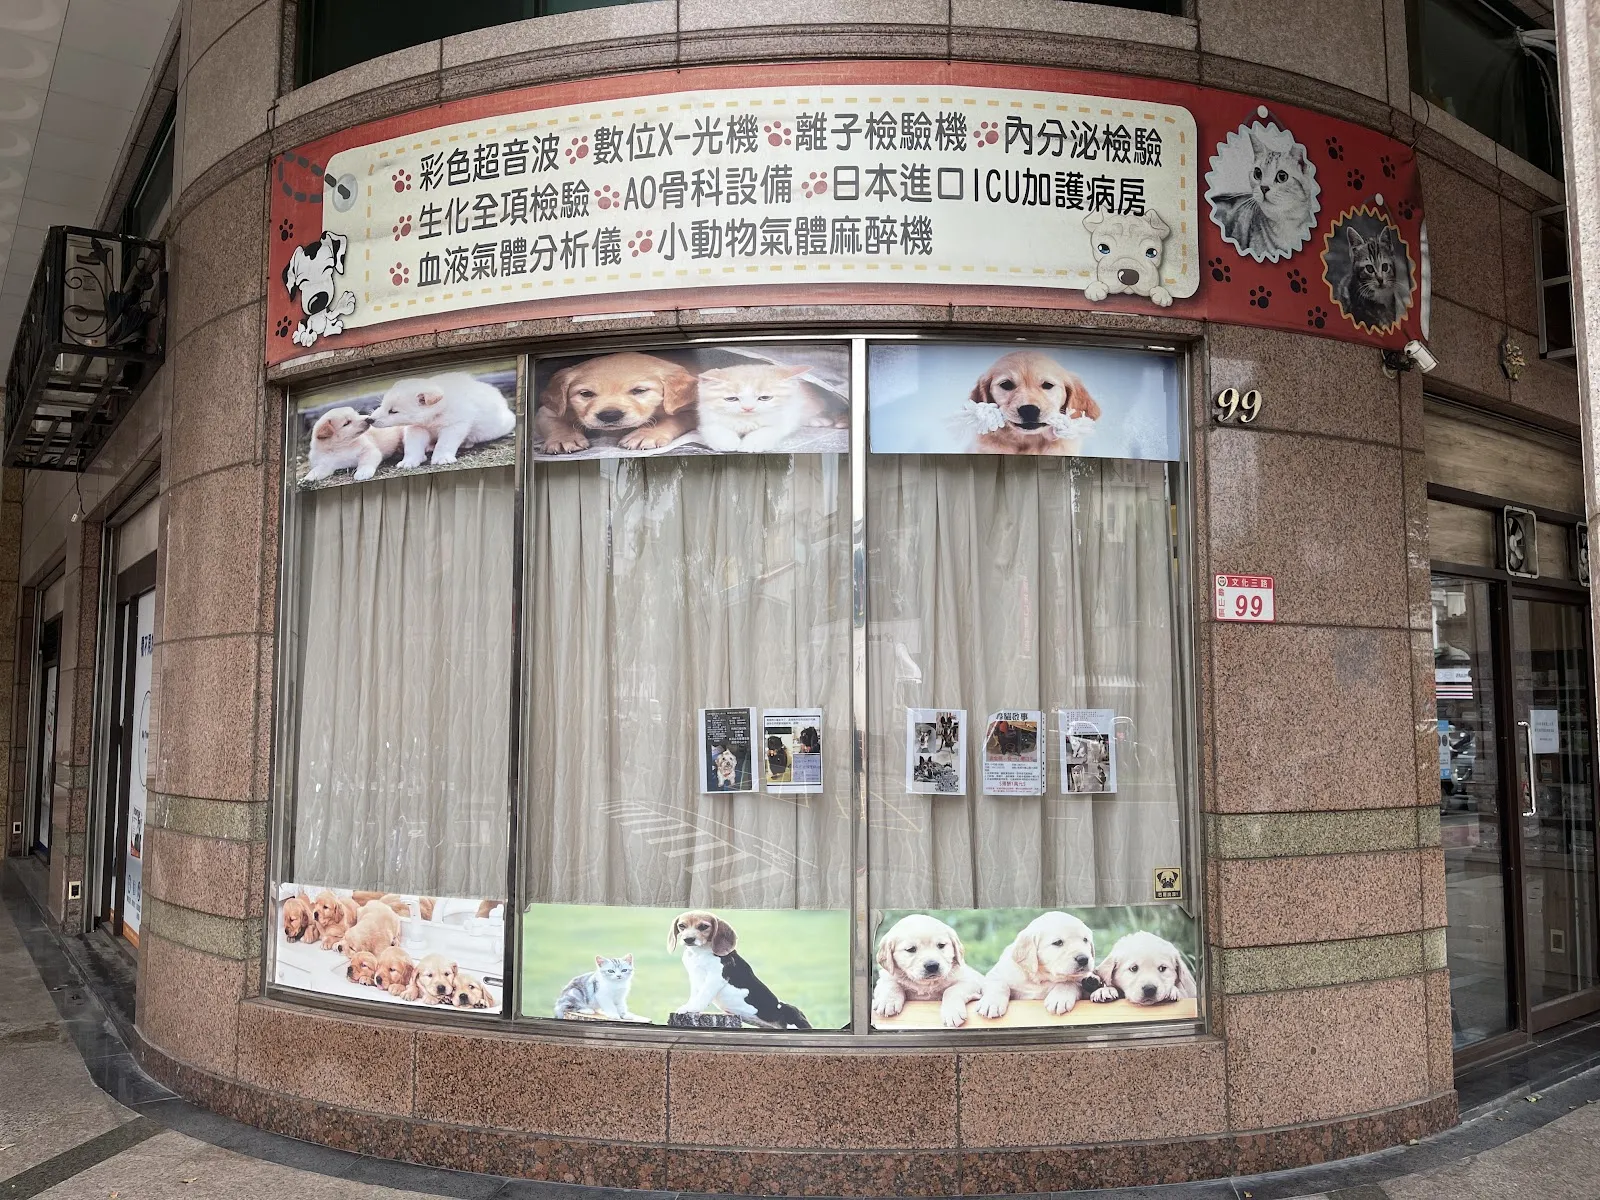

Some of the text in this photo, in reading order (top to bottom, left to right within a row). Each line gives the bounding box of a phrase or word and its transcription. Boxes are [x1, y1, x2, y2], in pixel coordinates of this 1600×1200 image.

[418, 132, 560, 192] 彩色超音波
[795, 111, 968, 151] 離子檢驗機
[1005, 115, 1163, 167] 內分泌檢驗
[418, 178, 591, 240] 生化全項檢驗
[833, 162, 1146, 217] 日本進口ICU加護病房
[416, 214, 933, 288] 血液氣體分析儀 小動物氣體麻醉機
[1216, 387, 1263, 424] 99
[1231, 577, 1268, 588] 文化三路
[1235, 594, 1263, 618] 99
